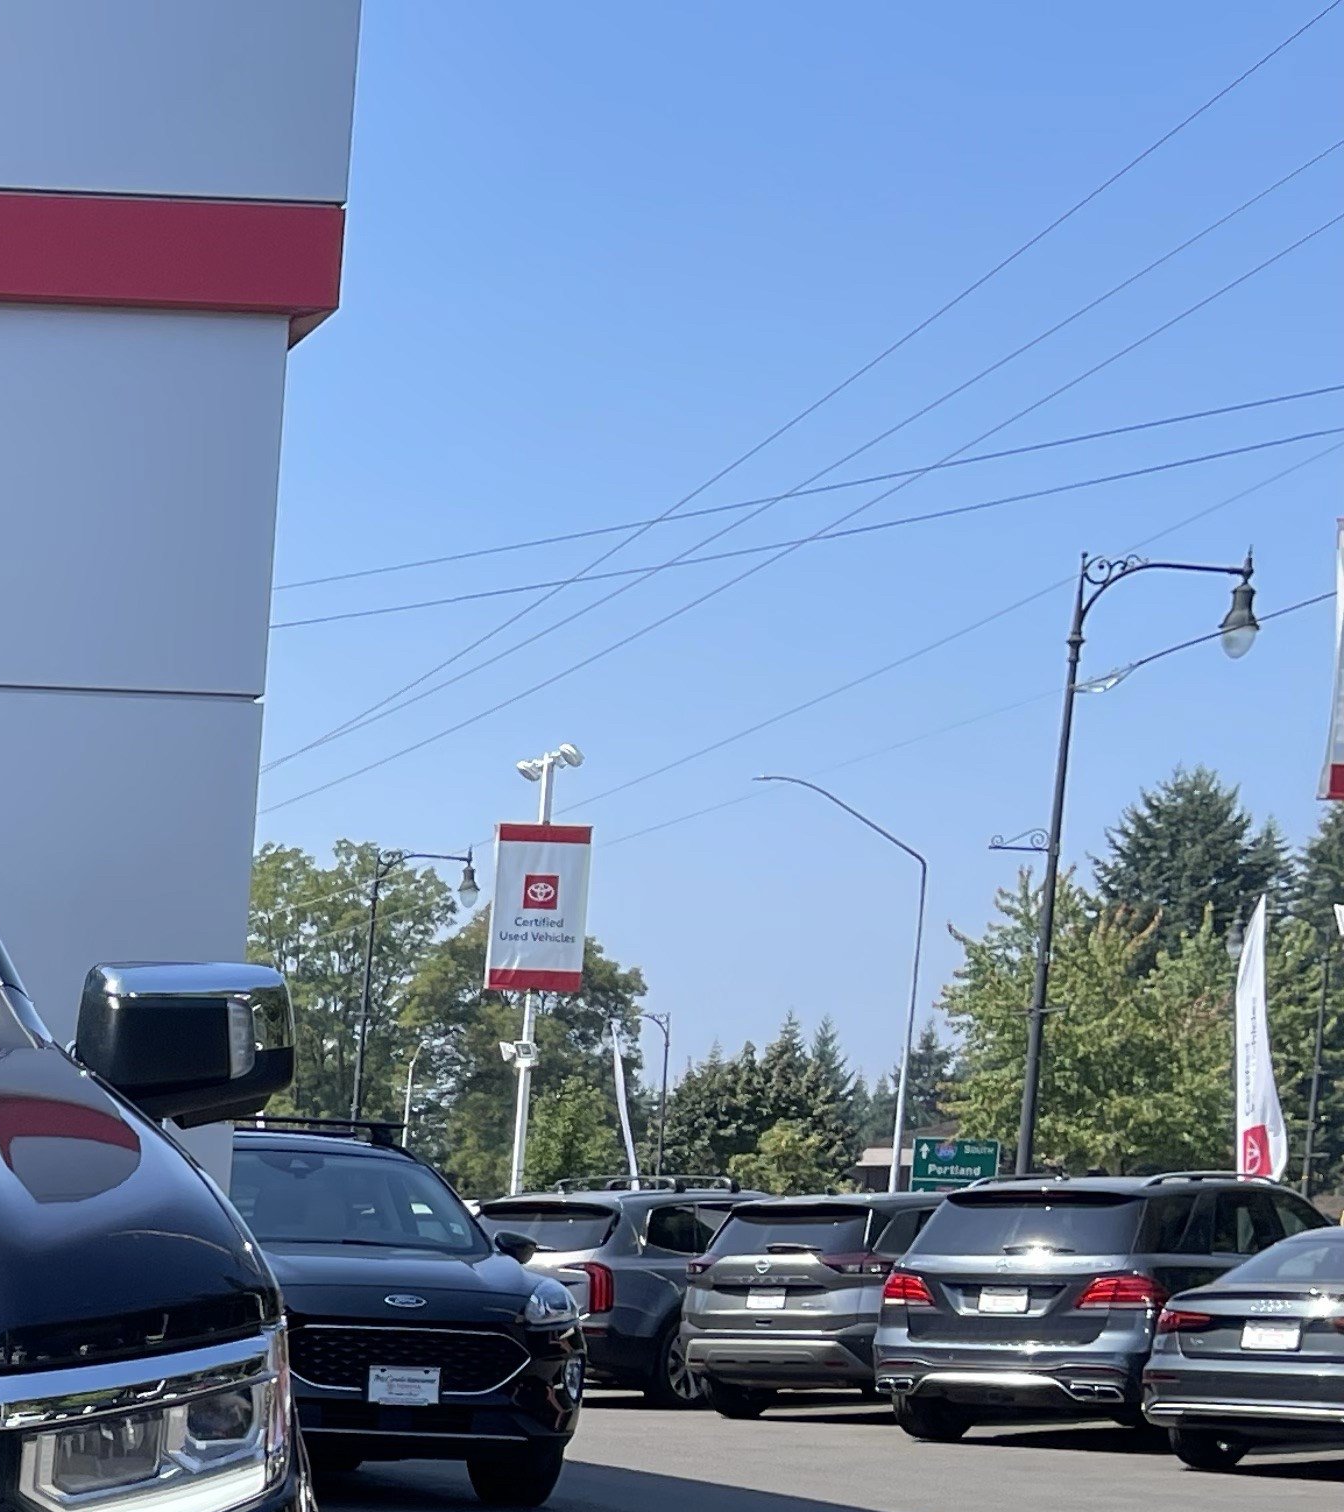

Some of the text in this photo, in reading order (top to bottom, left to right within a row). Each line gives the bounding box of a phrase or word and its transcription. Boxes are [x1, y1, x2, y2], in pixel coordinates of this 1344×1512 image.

[514, 917, 564, 928] Certified
[499, 931, 576, 944] Used Vehicles
[927, 1163, 981, 1176] Portland
